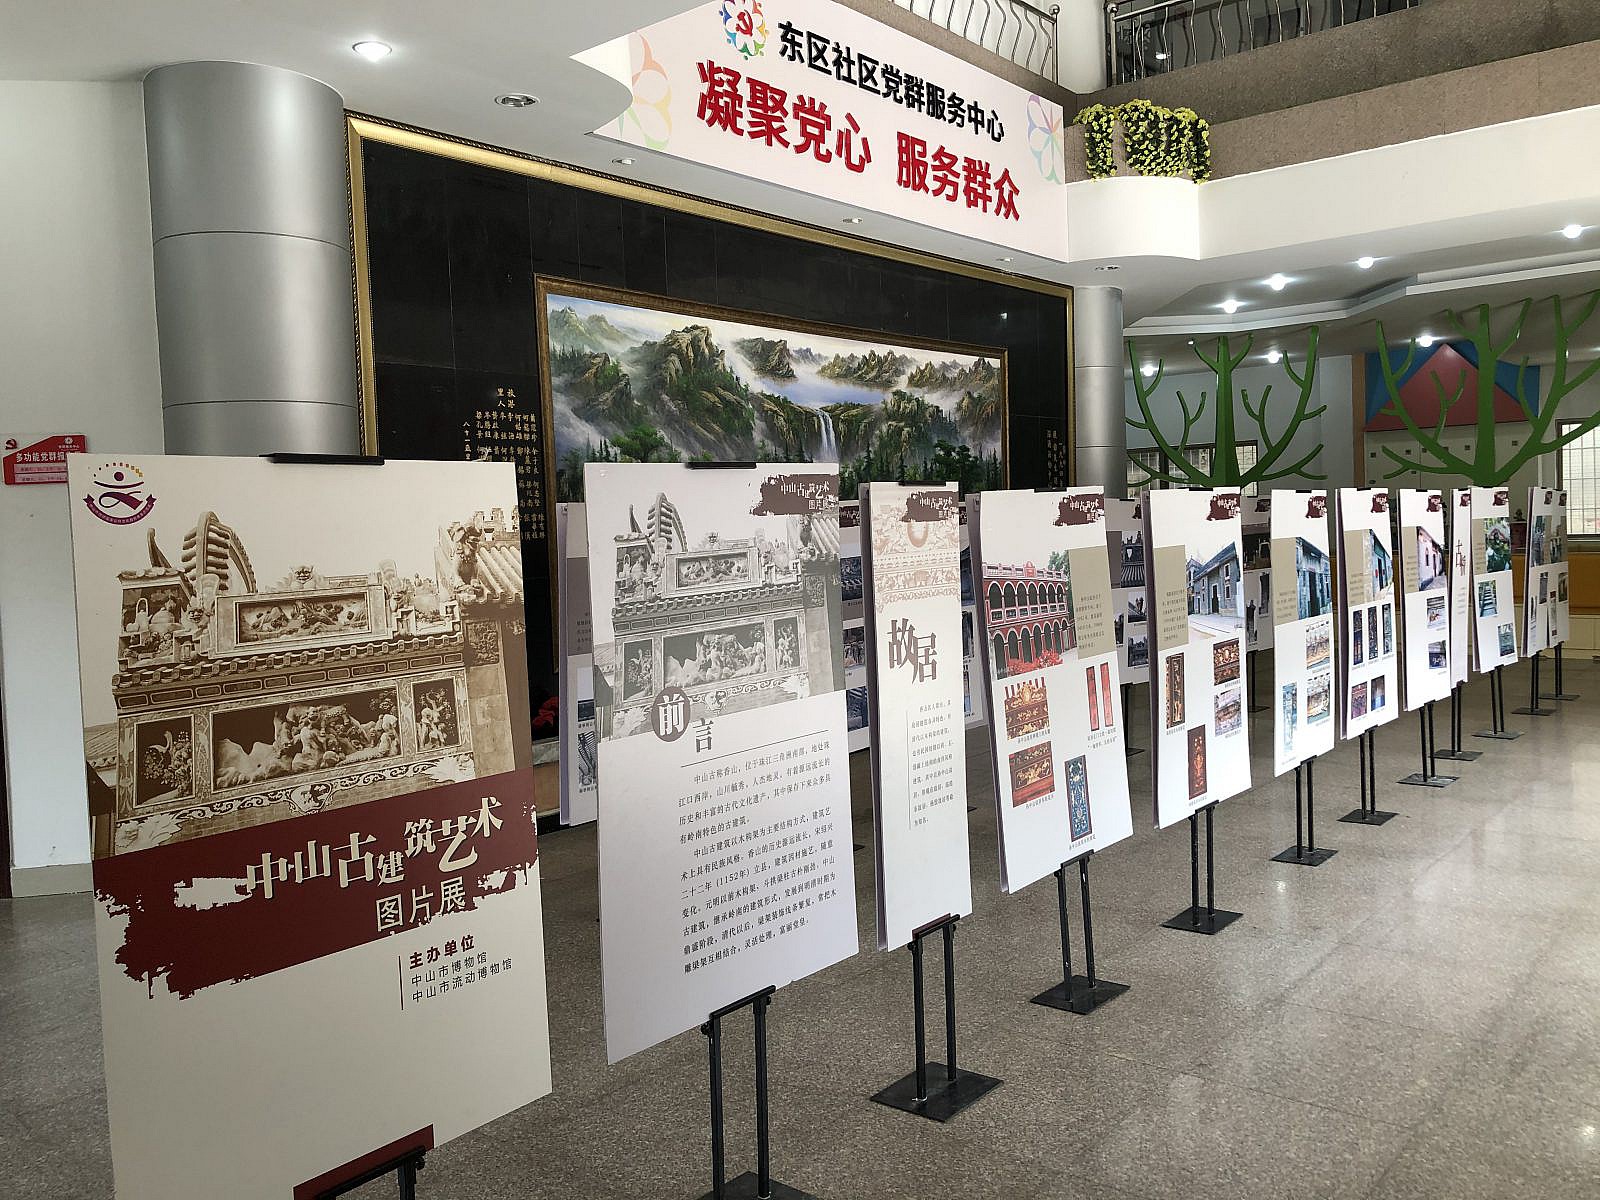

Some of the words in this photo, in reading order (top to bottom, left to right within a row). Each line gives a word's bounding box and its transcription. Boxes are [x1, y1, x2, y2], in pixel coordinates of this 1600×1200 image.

[778, 21, 1004, 142] 东区社区党群服务中心
[696, 60, 871, 173] 凝聚党心
[897, 131, 1020, 221] 服务群众
[16, 450, 80, 462] 多功能党群报
[886, 617, 938, 685] 故居
[656, 692, 714, 753] 前言
[247, 796, 503, 899] 中山古建筑艺术
[376, 876, 466, 932] 图片展
[408, 934, 476, 971] 主办单位
[410, 952, 488, 988] 中山市博物馆
[411, 958, 513, 1004] 中山市流动博物馆
